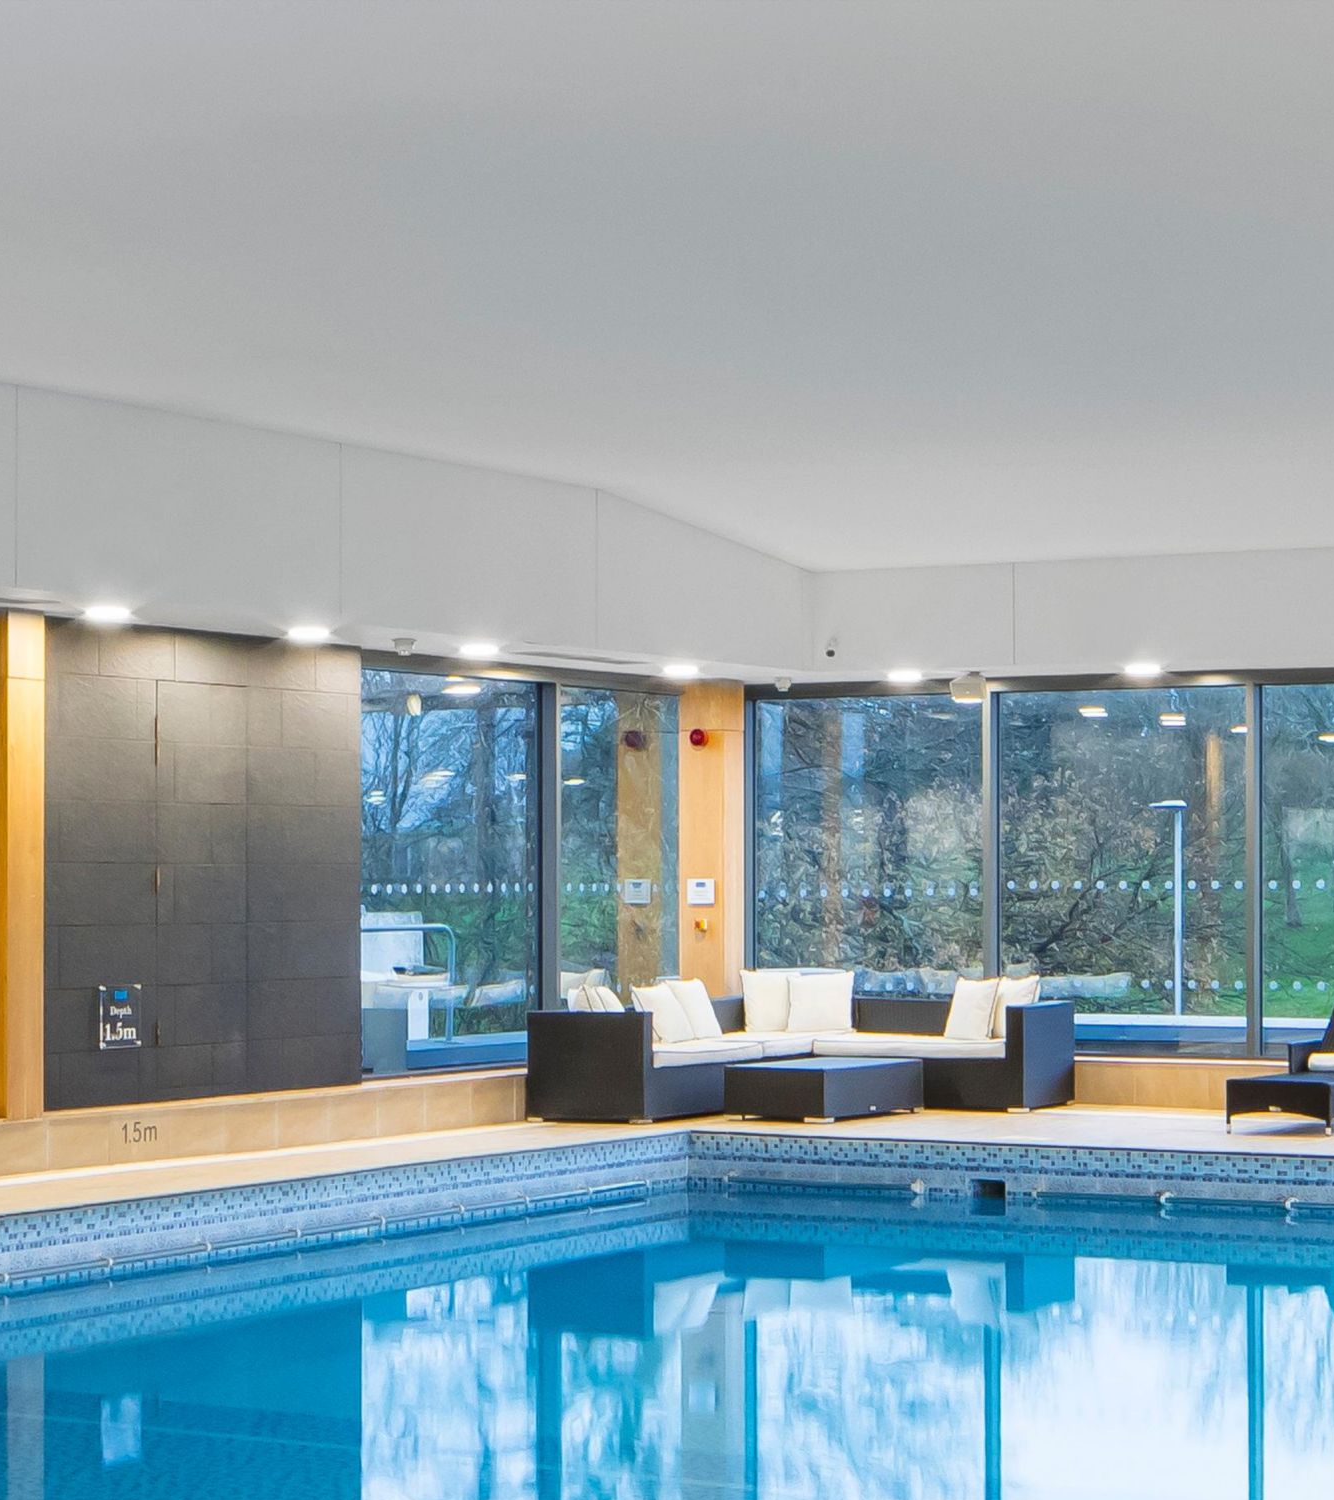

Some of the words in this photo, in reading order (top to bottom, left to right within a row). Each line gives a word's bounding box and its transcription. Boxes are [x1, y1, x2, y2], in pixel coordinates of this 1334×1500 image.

[110, 1005, 132, 1018] Depth
[105, 1022, 137, 1041] 1.5m
[121, 1121, 158, 1145] 1.5m
